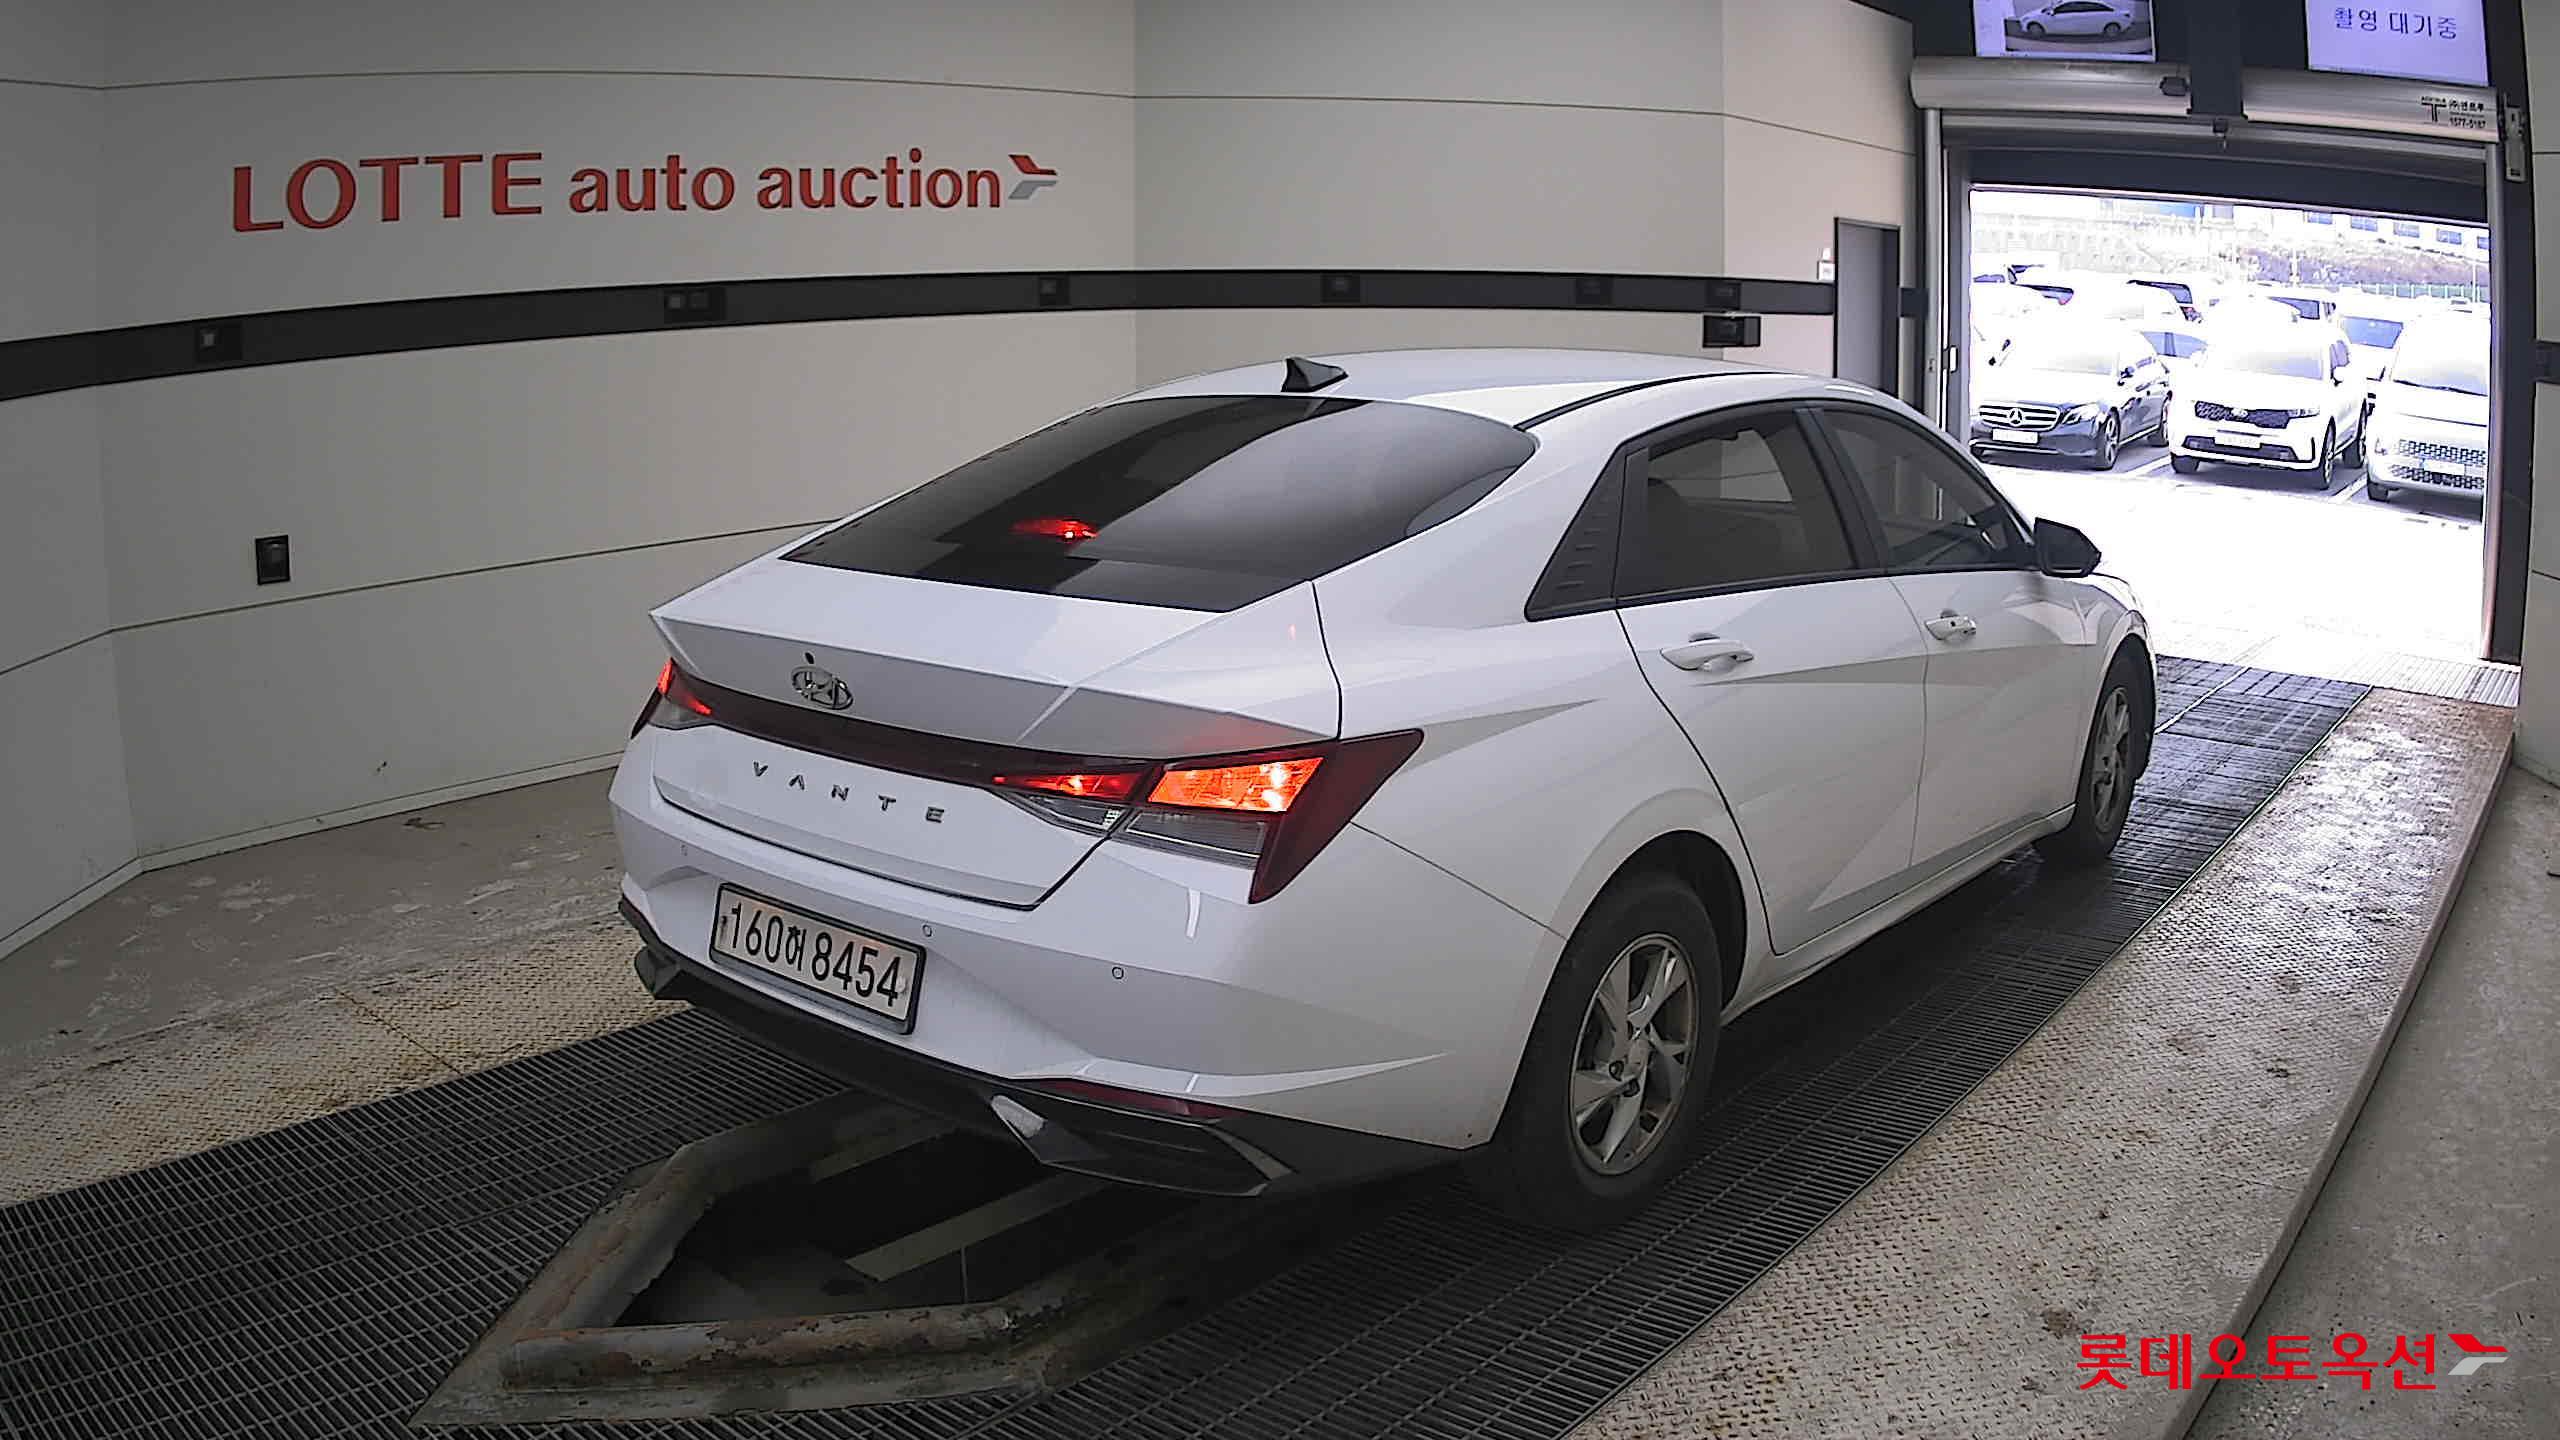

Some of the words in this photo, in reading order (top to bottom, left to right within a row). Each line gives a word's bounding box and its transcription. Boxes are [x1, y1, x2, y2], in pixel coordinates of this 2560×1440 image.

[2335, 8, 2377, 32] 촬영
[2389, 12, 2457, 40] 대기중
[234, 153, 543, 232] LOTTE
[569, 154, 735, 213] auto
[756, 148, 1002, 210] auction
[753, 761, 944, 823] VANTE
